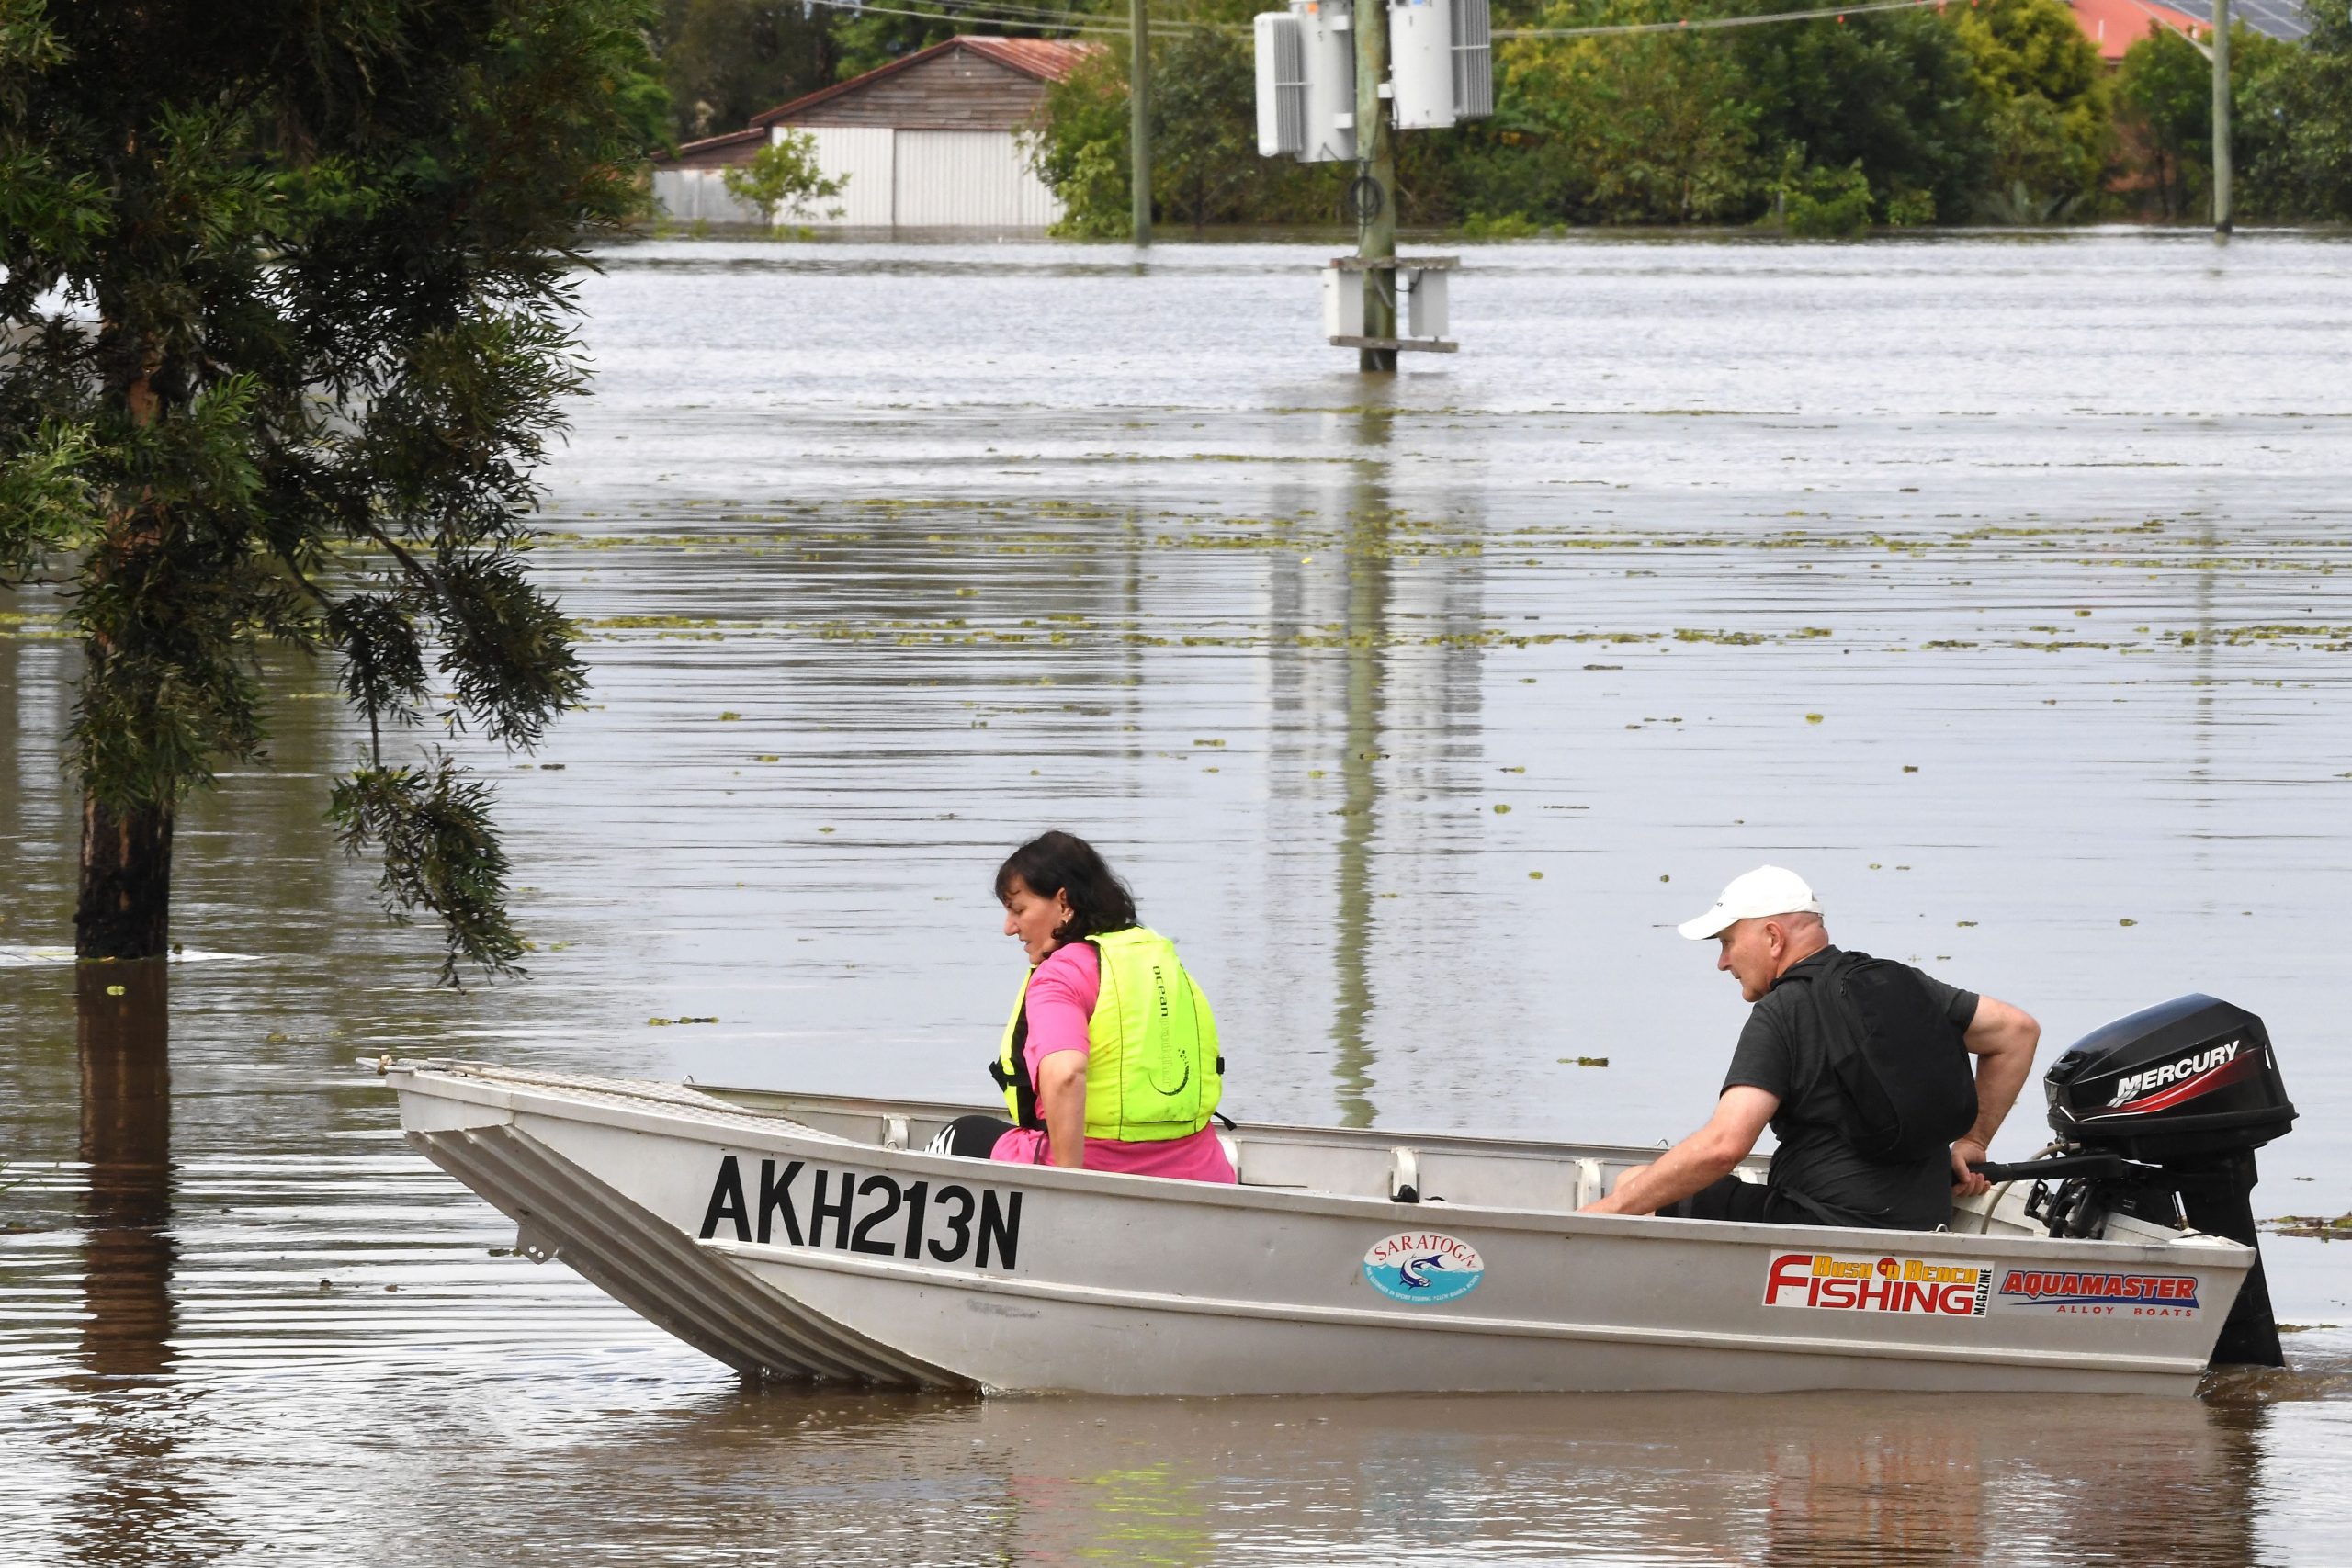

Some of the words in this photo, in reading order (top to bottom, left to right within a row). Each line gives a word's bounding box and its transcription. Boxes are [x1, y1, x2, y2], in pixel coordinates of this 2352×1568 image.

[2117, 1040, 2240, 1099] MERCURY
[698, 1155, 1023, 1270] AKH213N
[1374, 1235, 1476, 1268] SARATOGA
[1764, 1254, 1976, 1315] FISHING
[1973, 1269, 1992, 1316] MAGAZINE
[2001, 1271, 2198, 1300] AQUAMASTER
[2056, 1304, 2116, 1314] ALLOY
[2132, 1307, 2193, 1317] BOATS
